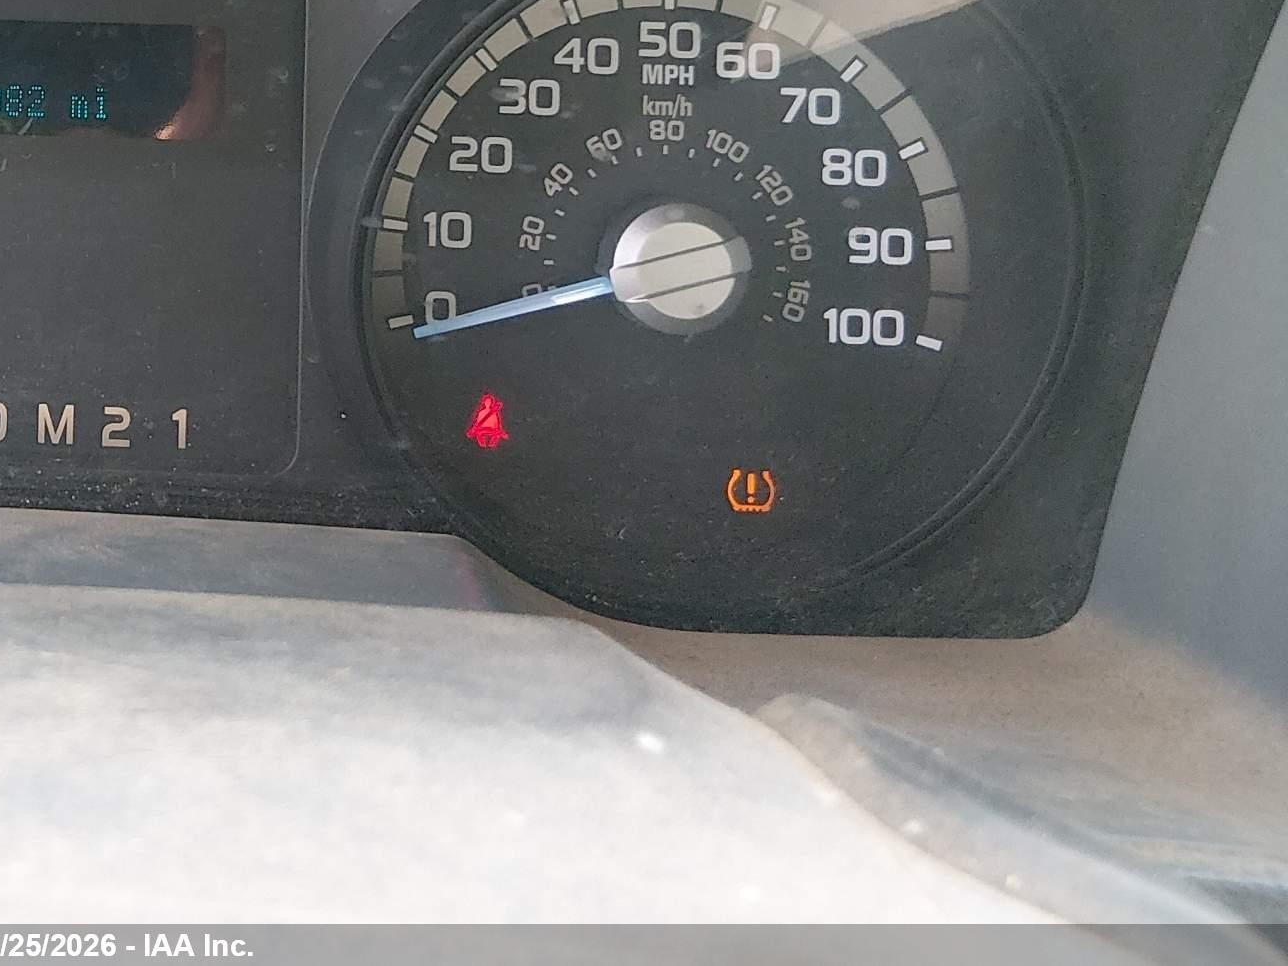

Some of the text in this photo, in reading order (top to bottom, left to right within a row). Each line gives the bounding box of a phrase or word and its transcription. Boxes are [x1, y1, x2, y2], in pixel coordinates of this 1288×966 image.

[553, 37, 620, 75] 40
[638, 21, 702, 59] 50
[641, 64, 695, 87] MPH
[715, 42, 781, 80] 60
[71, 86, 107, 119] mi
[498, 78, 561, 117] 30
[641, 94, 694, 119] km/h
[779, 87, 841, 125] 70
[585, 127, 624, 161] 60
[648, 119, 686, 142] 80
[706, 128, 750, 163] 100
[449, 135, 513, 174] 20
[820, 148, 887, 187] 80
[543, 163, 574, 197] 40
[755, 164, 794, 207] 120
[423, 211, 473, 250] 10
[519, 215, 545, 252] 20
[786, 216, 813, 262] 140
[847, 227, 913, 266] 90
[424, 291, 458, 327] 0
[782, 278, 811, 323] 160
[823, 308, 905, 346] 100
[36, 403, 75, 445] M
[101, 406, 132, 448] 2
[171, 408, 189, 449] 1
